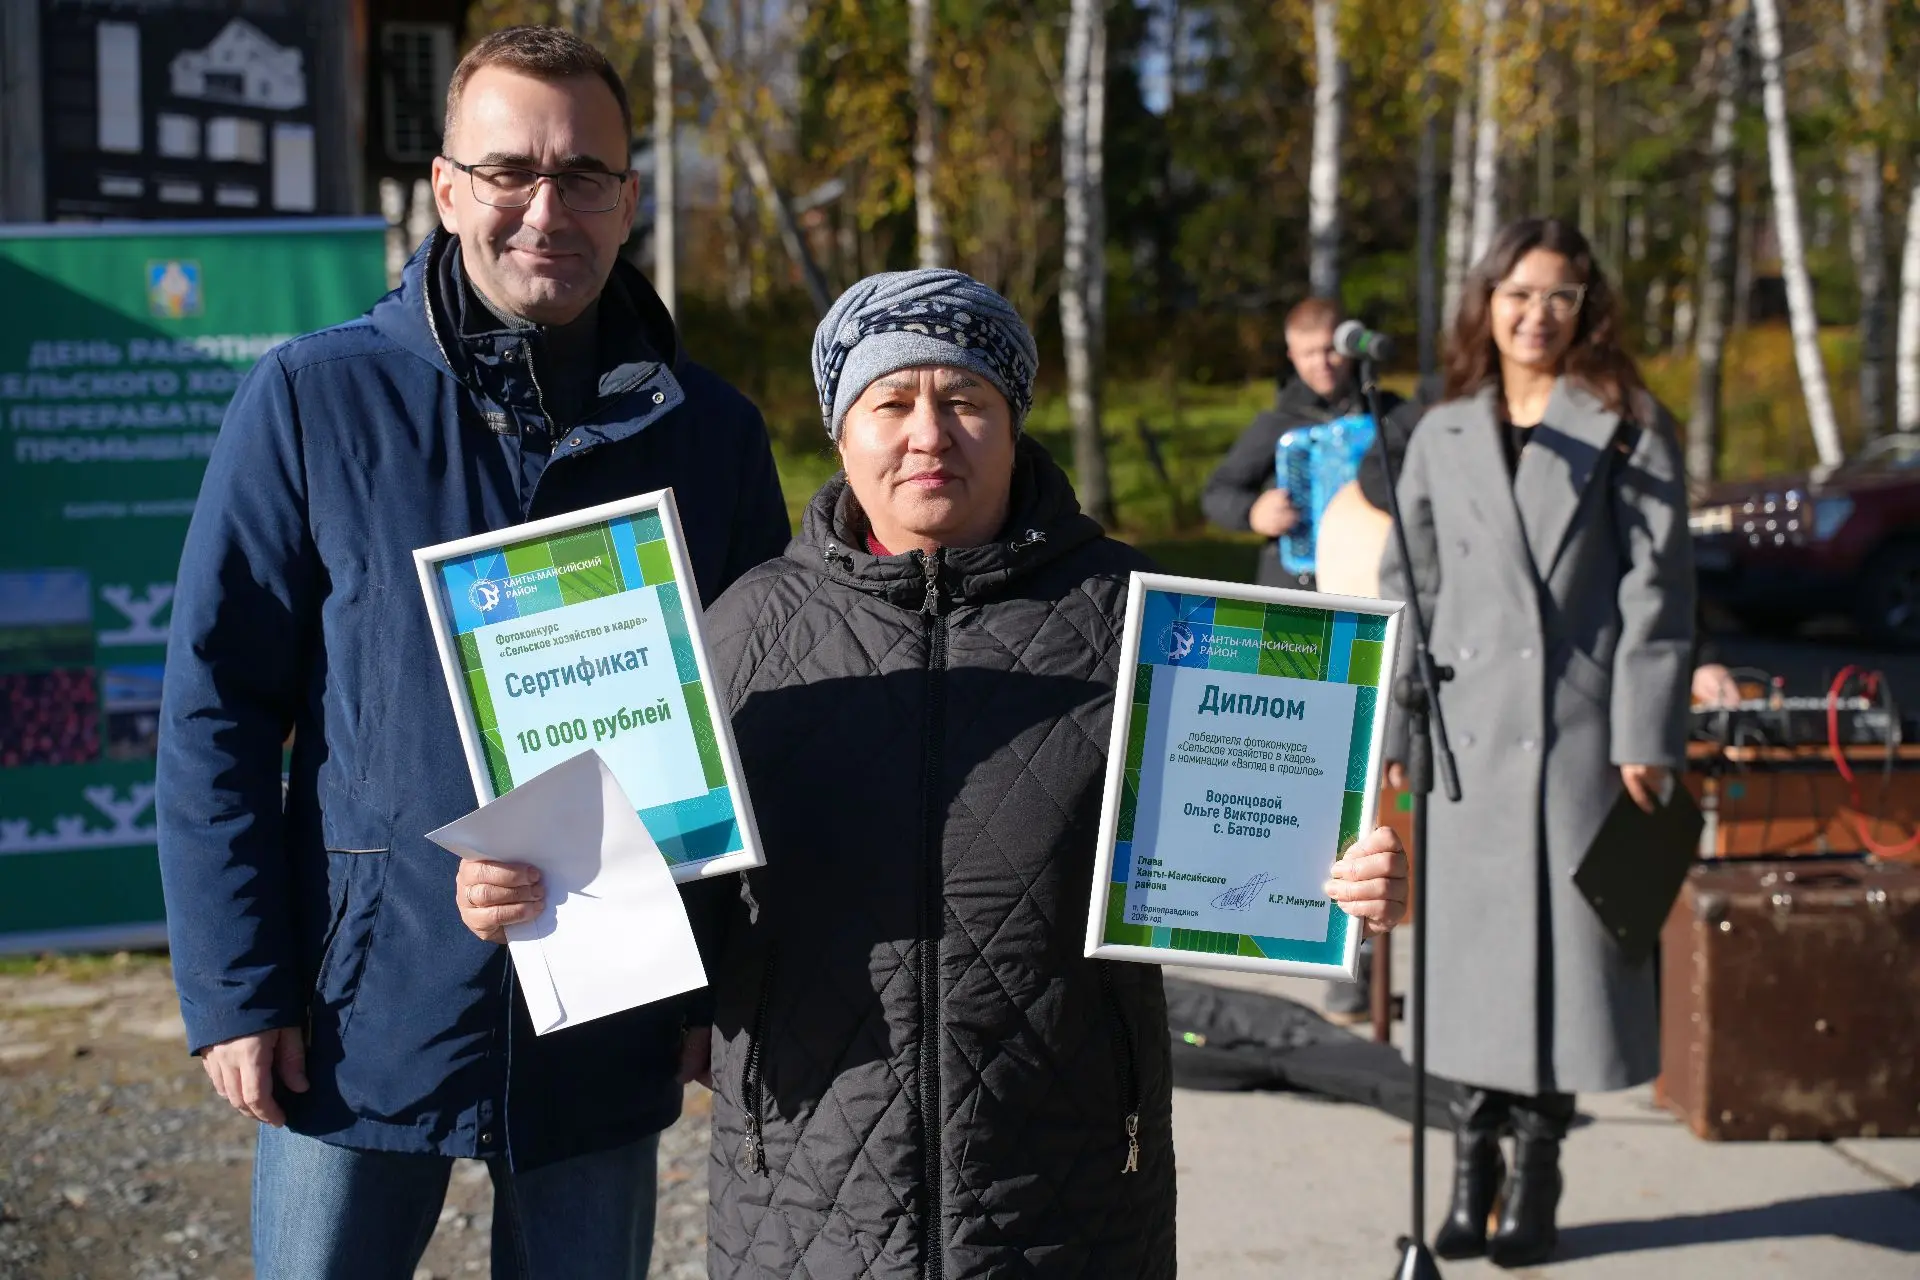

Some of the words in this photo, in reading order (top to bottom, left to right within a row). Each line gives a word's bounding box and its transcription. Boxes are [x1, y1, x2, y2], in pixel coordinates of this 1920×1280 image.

[29, 341, 122, 366] ДЕНЬ
[128, 333, 294, 362] РАБОТНИ
[502, 556, 602, 589] ХАНТЫ-МАНСИЙСКИЙ
[505, 585, 537, 599] РАЙОН
[495, 623, 559, 646] Фотоконкурс
[499, 640, 551, 658] «Сельское
[553, 627, 602, 646] хозяйство
[604, 624, 610, 633] в
[612, 616, 648, 632] кадре»
[1201, 633, 1318, 655] ХАНТЫ-МАНСИЙСКИЙ
[1199, 645, 1238, 658] РАЙОН
[505, 647, 649, 698] Сертификат
[1198, 684, 1306, 721] Диплом
[517, 730, 541, 754] 10
[545, 718, 588, 748] 000
[592, 698, 672, 742] рублей
[1177, 741, 1225, 756] «Сельское
[1227, 747, 1274, 760] хозяйство
[1275, 753, 1282, 761] в
[1284, 754, 1316, 765] кадре»
[1188, 731, 1242, 745] победителя
[1243, 737, 1308, 753] фотоконкурса
[1169, 753, 1176, 762] в
[1177, 754, 1229, 767] номинации
[1231, 758, 1267, 772] «Взгляд
[1269, 763, 1275, 772] в
[1277, 764, 1323, 777] прошлое»
[1205, 789, 1282, 810] Воронцовой
[1183, 802, 1220, 819] Ольге
[1223, 806, 1300, 828] Викторовне,
[1213, 822, 1223, 834] с.
[1227, 822, 1271, 838] Батово
[1137, 856, 1163, 867] Глава
[1134, 879, 1167, 890] района
[1136, 867, 1227, 884] Ханты-Мансийского
[1140, 904, 1199, 917] Горноправдинск
